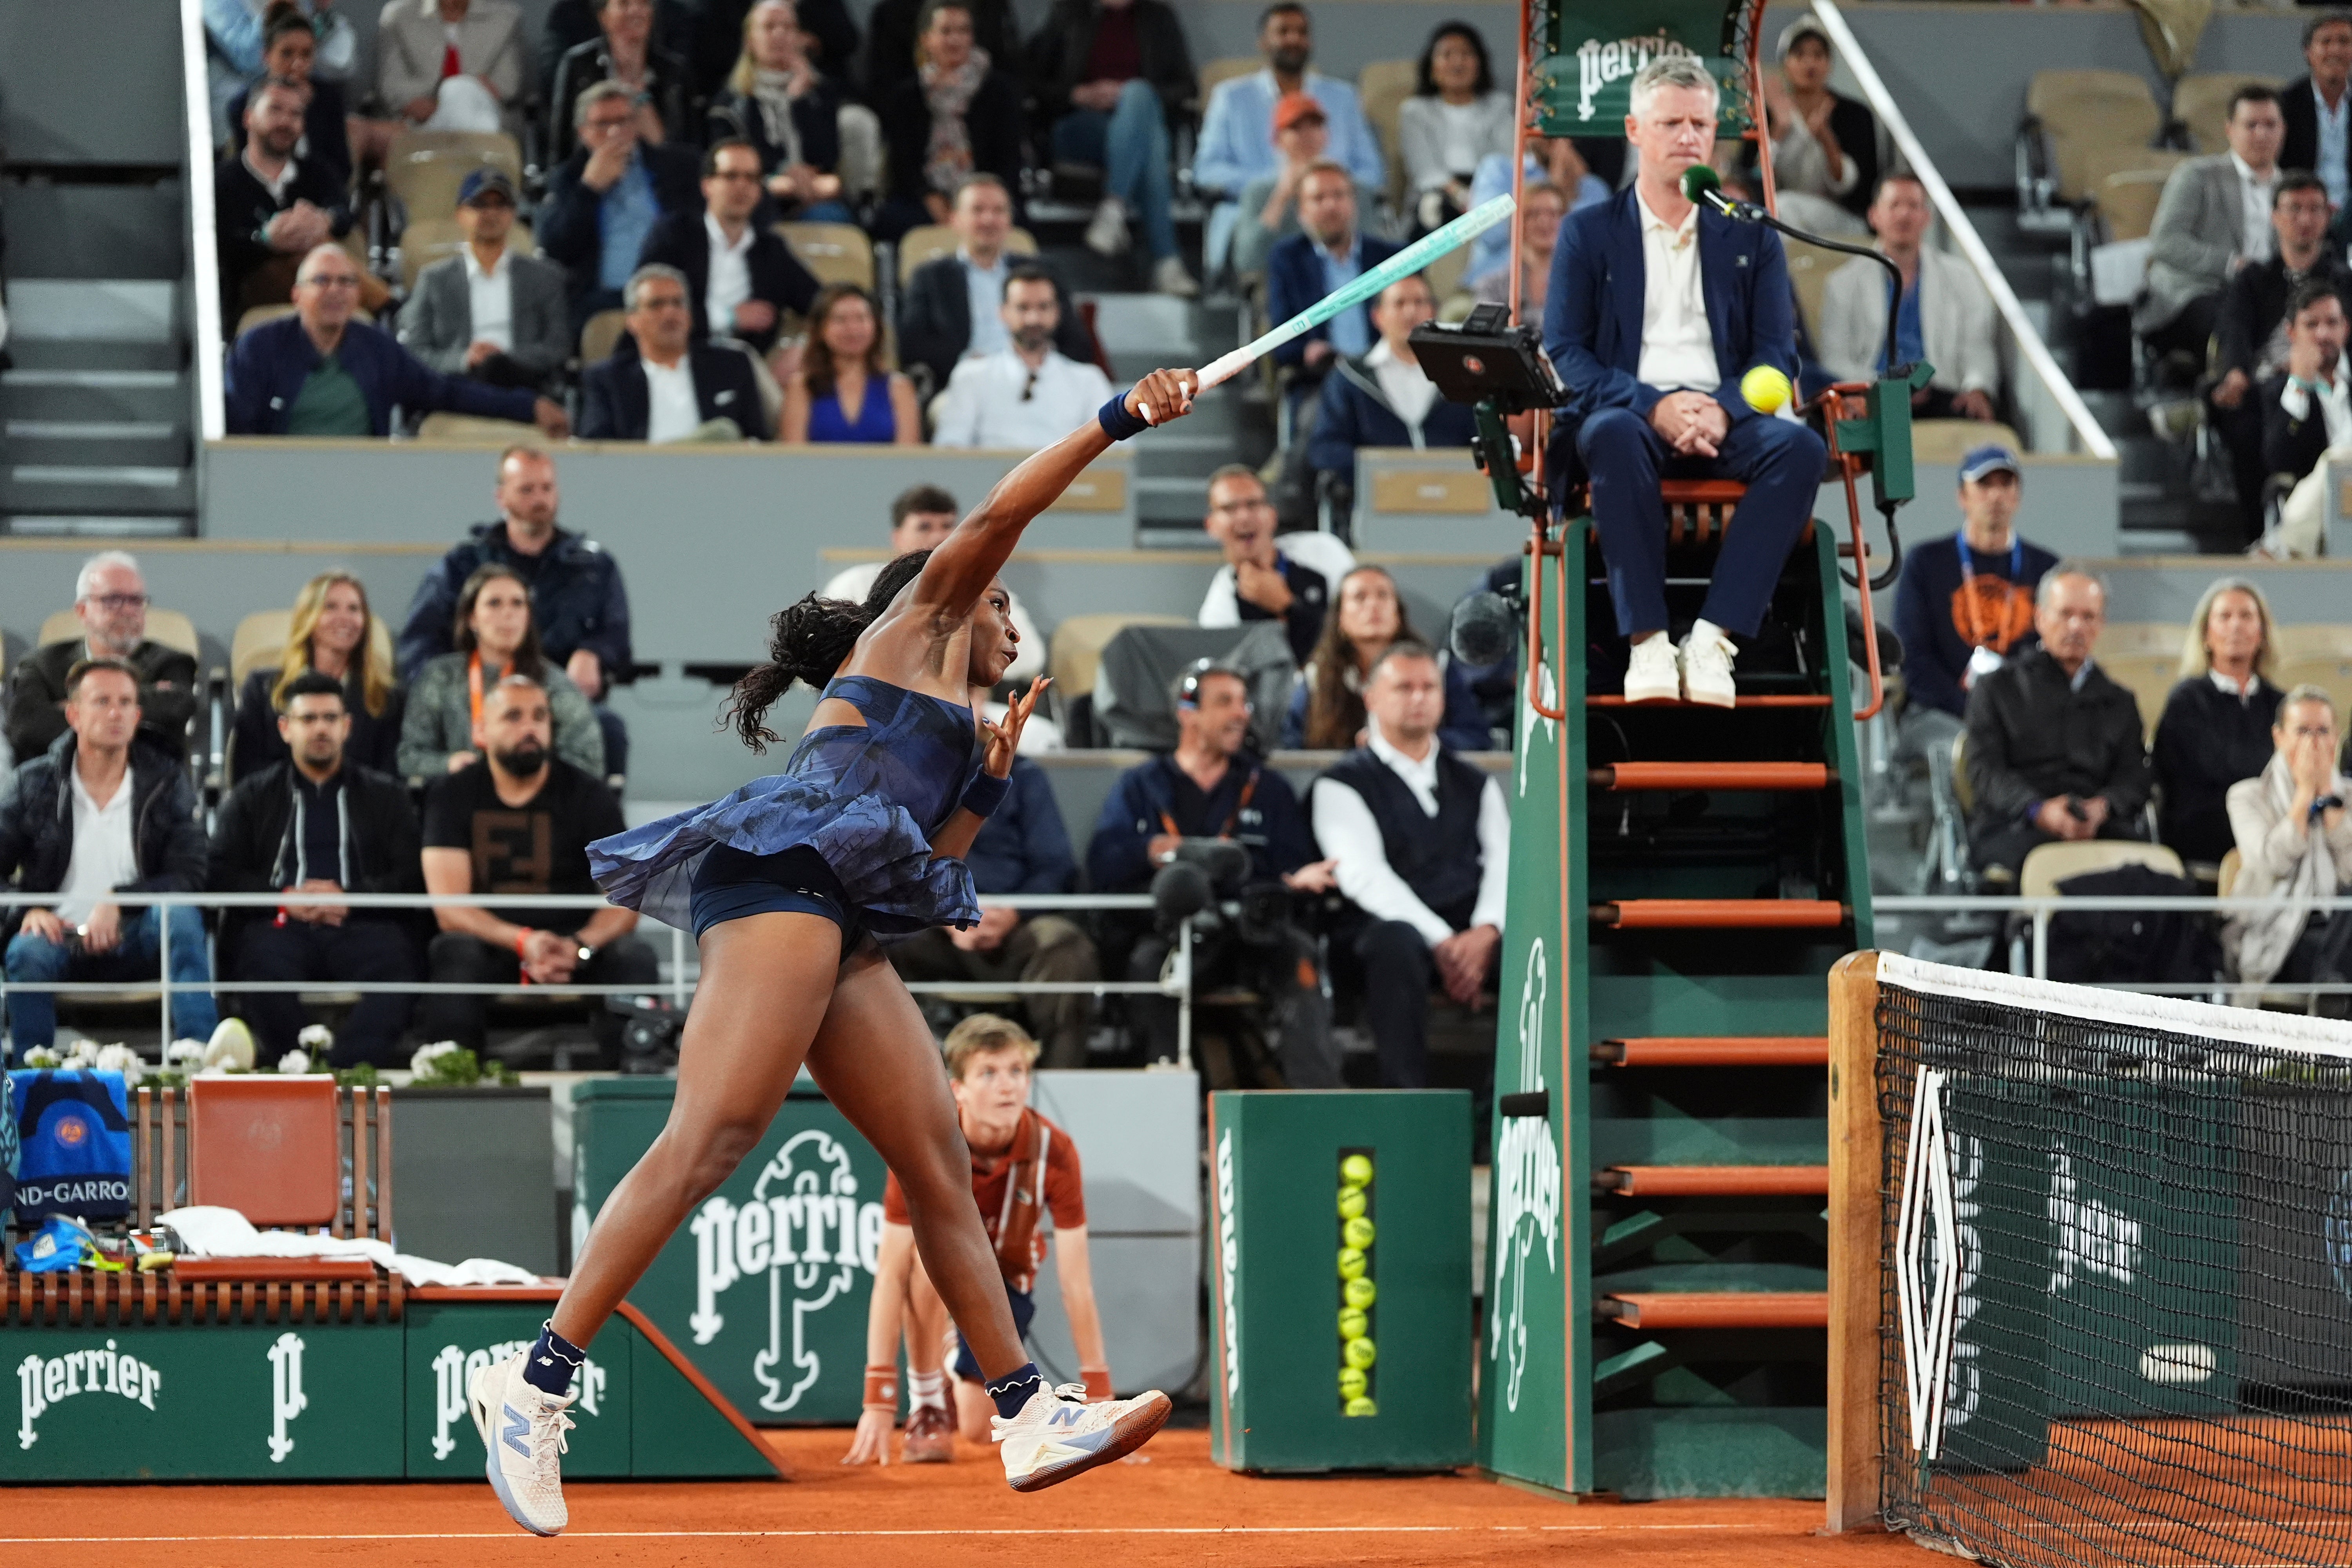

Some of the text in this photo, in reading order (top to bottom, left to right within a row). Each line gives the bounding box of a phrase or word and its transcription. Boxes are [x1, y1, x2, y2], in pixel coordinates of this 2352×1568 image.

[15, 1181, 129, 1206] ND-GARRO
[690, 1174, 884, 1345] perrie
[17, 1338, 160, 1450] perrier
[1047, 1407, 1086, 1426] N
